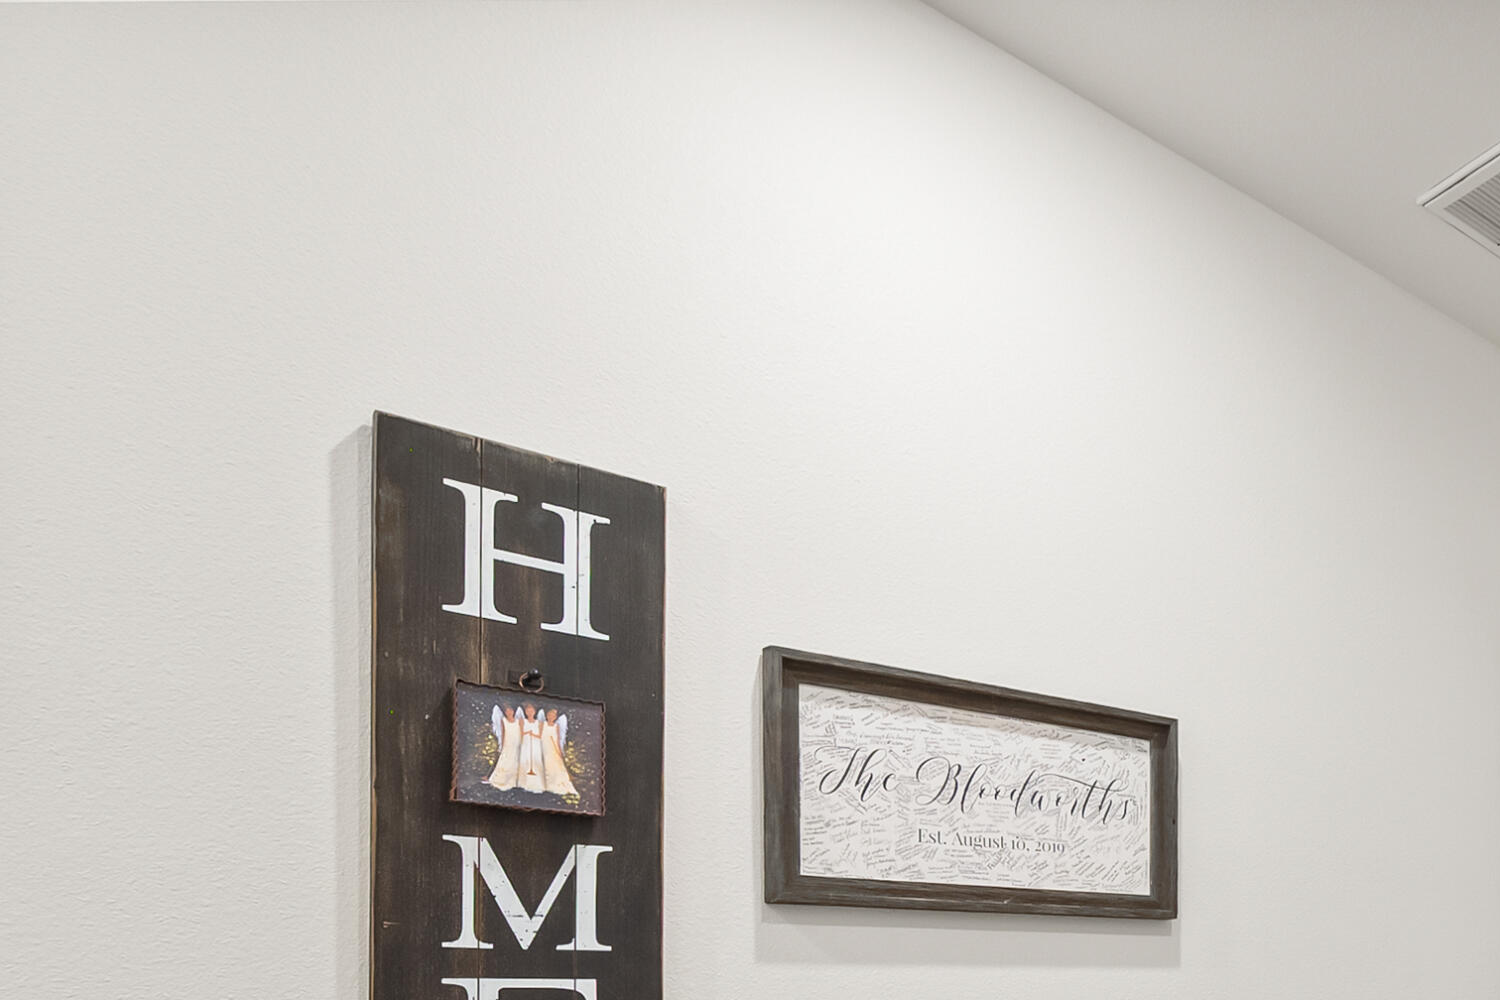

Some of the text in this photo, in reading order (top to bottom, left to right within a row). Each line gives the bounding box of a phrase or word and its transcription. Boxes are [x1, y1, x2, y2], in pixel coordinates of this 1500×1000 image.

[814, 745, 1130, 825] The Bloodworths
[917, 828, 947, 845] Est.
[952, 832, 1006, 850] August
[1034, 842, 1065, 855] 2019
